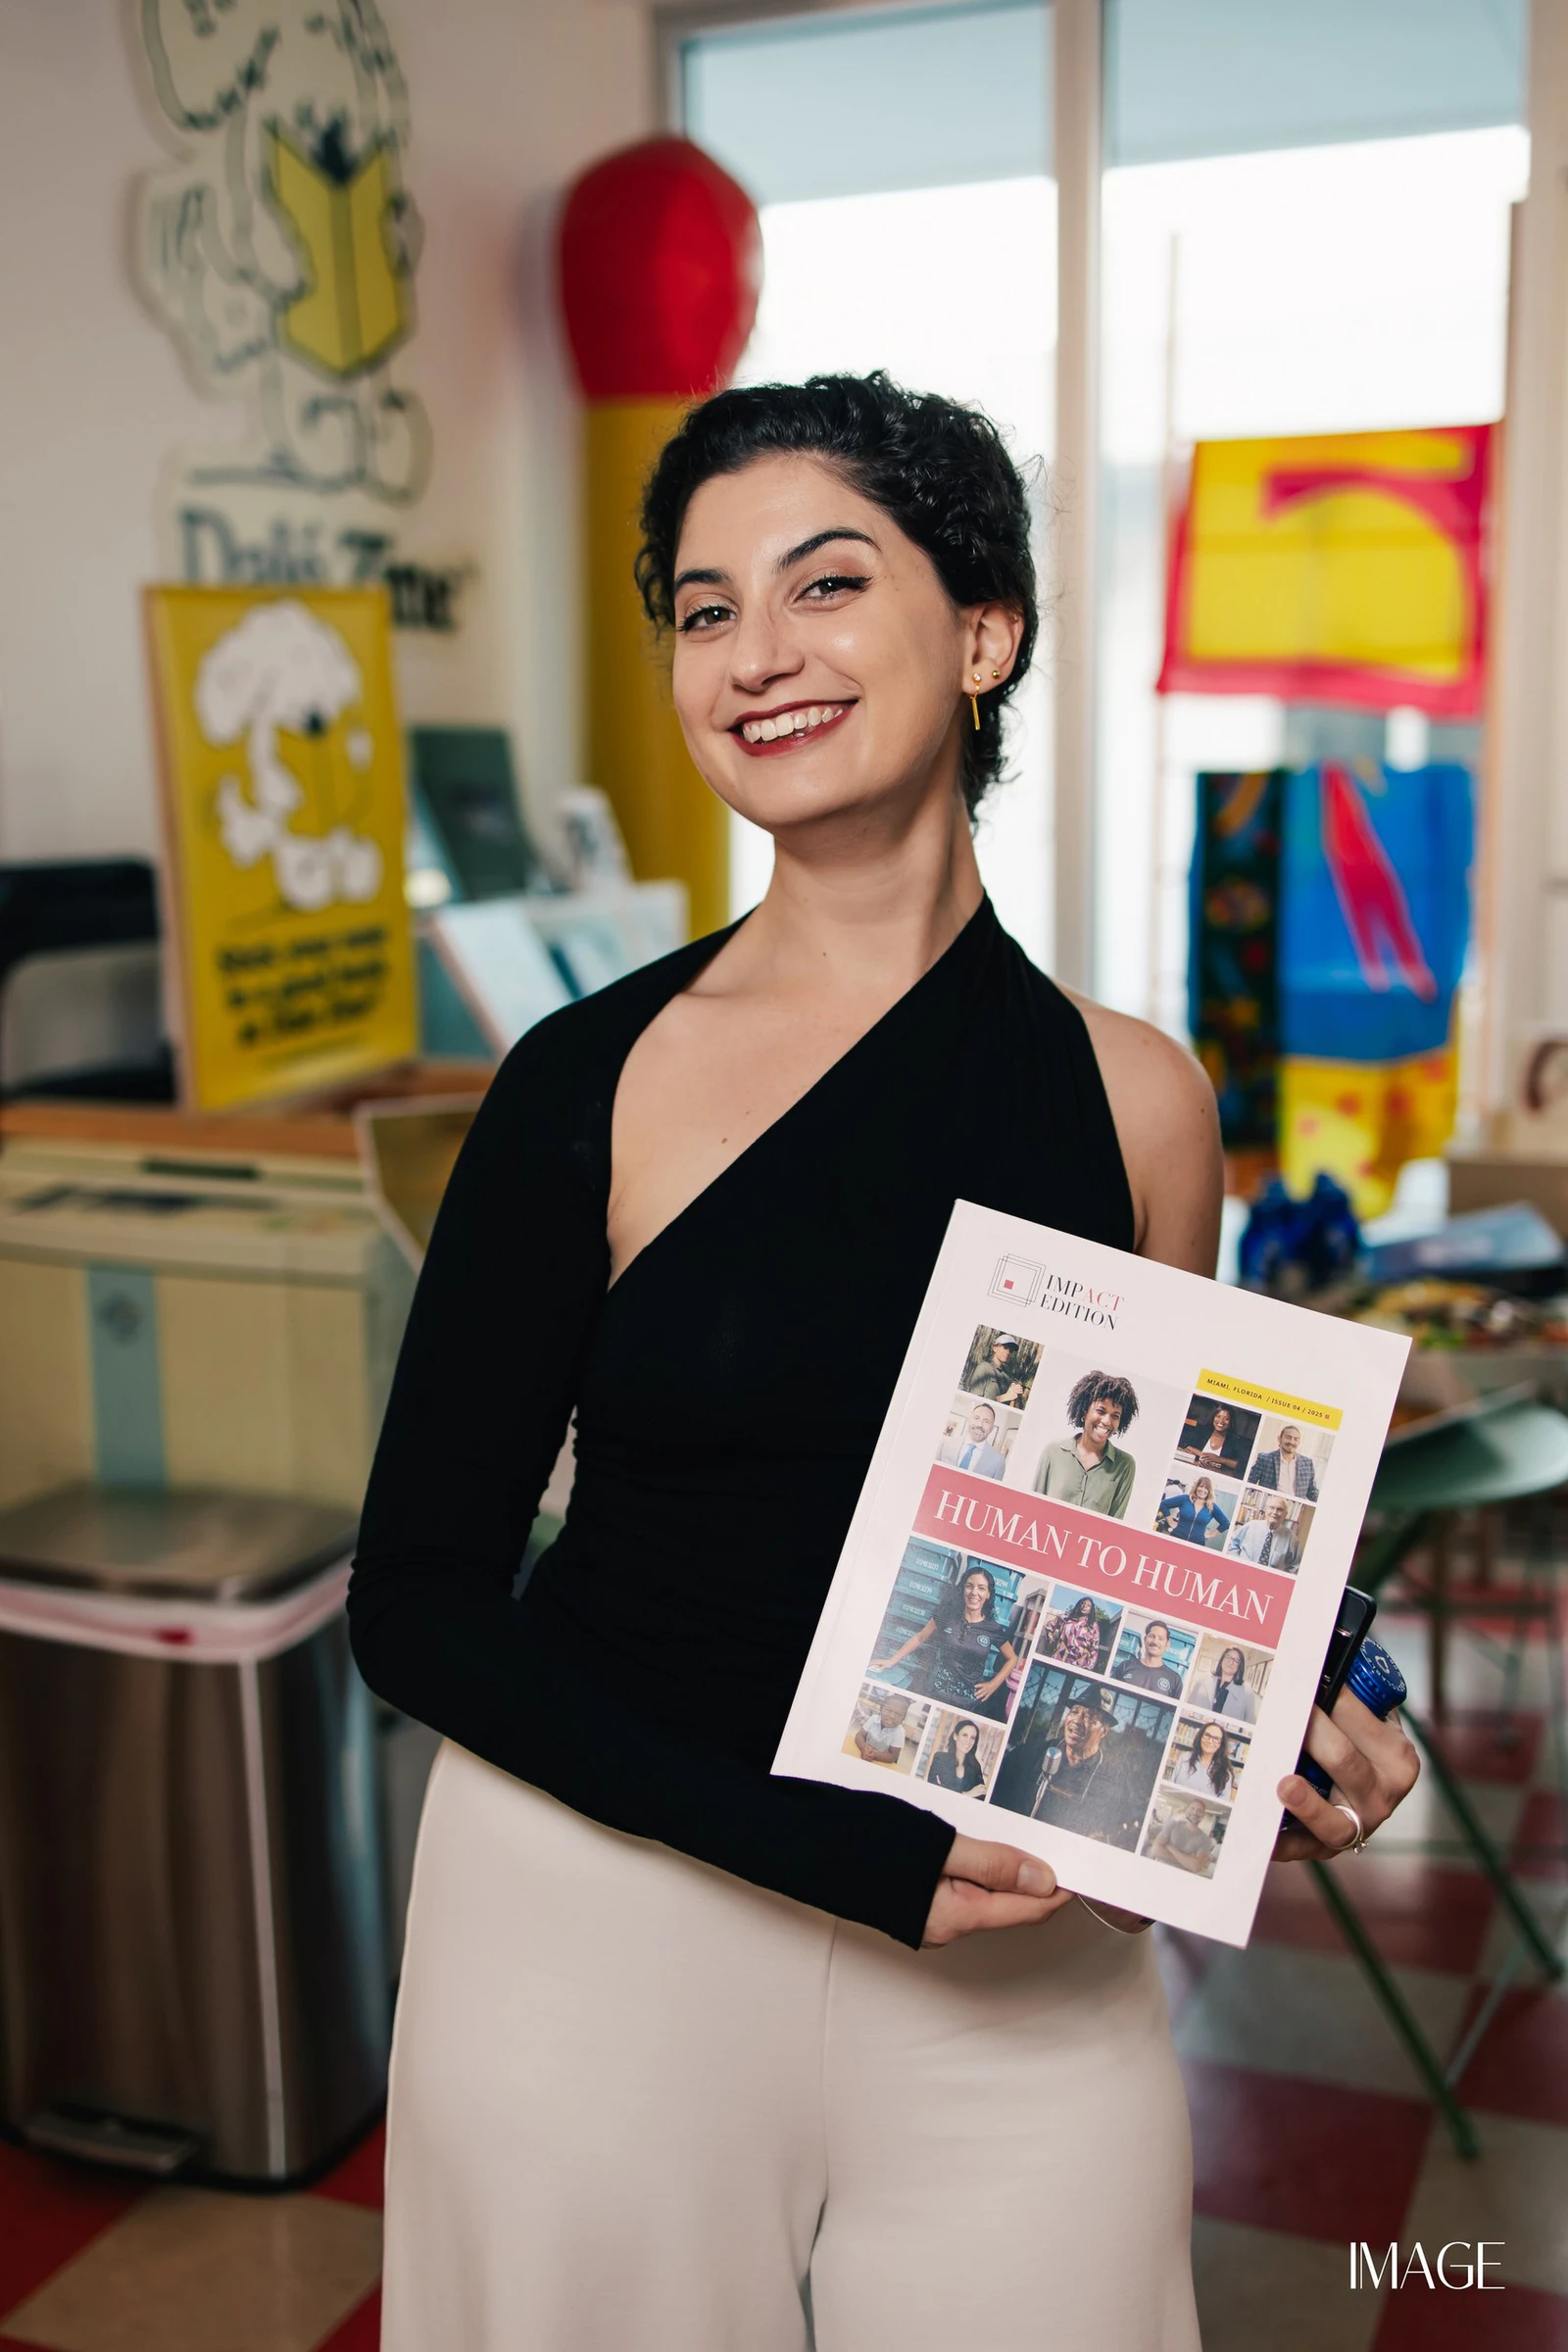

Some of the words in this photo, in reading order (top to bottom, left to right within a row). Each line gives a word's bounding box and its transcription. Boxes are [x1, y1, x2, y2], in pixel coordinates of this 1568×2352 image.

[1046, 1275, 1125, 1311] IMPACT
[1040, 1294, 1118, 1331] EDITION
[1233, 1386, 1262, 1399] FLORIDA
[1271, 1397, 1291, 1408] ISSUE
[1307, 1408, 1323, 1418] 2025
[933, 1489, 1072, 1560] HUMAN
[1076, 1536, 1128, 1577] TO
[1131, 1553, 1274, 1625] HUMAN
